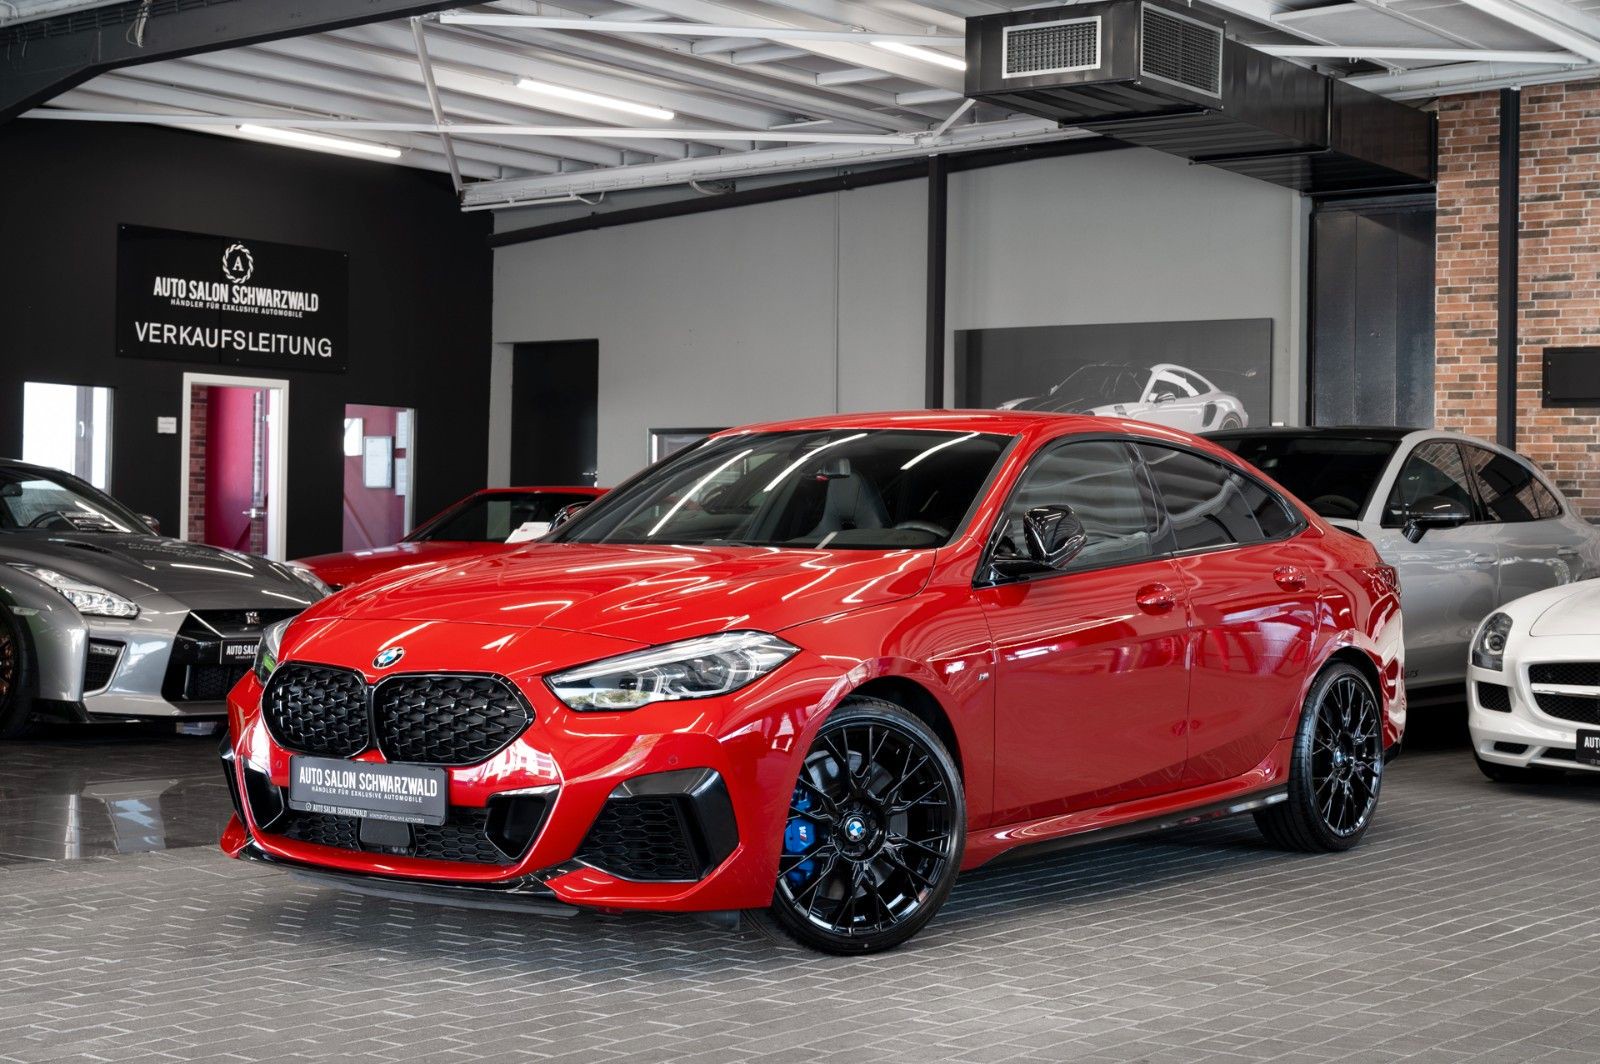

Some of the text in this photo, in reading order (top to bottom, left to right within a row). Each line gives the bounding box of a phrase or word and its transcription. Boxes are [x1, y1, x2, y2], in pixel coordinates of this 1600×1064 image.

[153, 276, 319, 312] AUTO SALON SCHWARZWALD
[170, 298, 303, 318] HÄNDLER FÜR EXKLUSIVE AUTOMOBILE
[135, 321, 332, 357] VERKAUFSLEITUNG
[226, 645, 243, 655] AUTO
[1584, 736, 1600, 748] AUT
[299, 766, 437, 797] AUTO SALON SCHWARZWALD
[338, 788, 349, 796] FÜR
[351, 790, 382, 799] EXKLUSIVE
[384, 793, 423, 803] AUTOMOBILE
